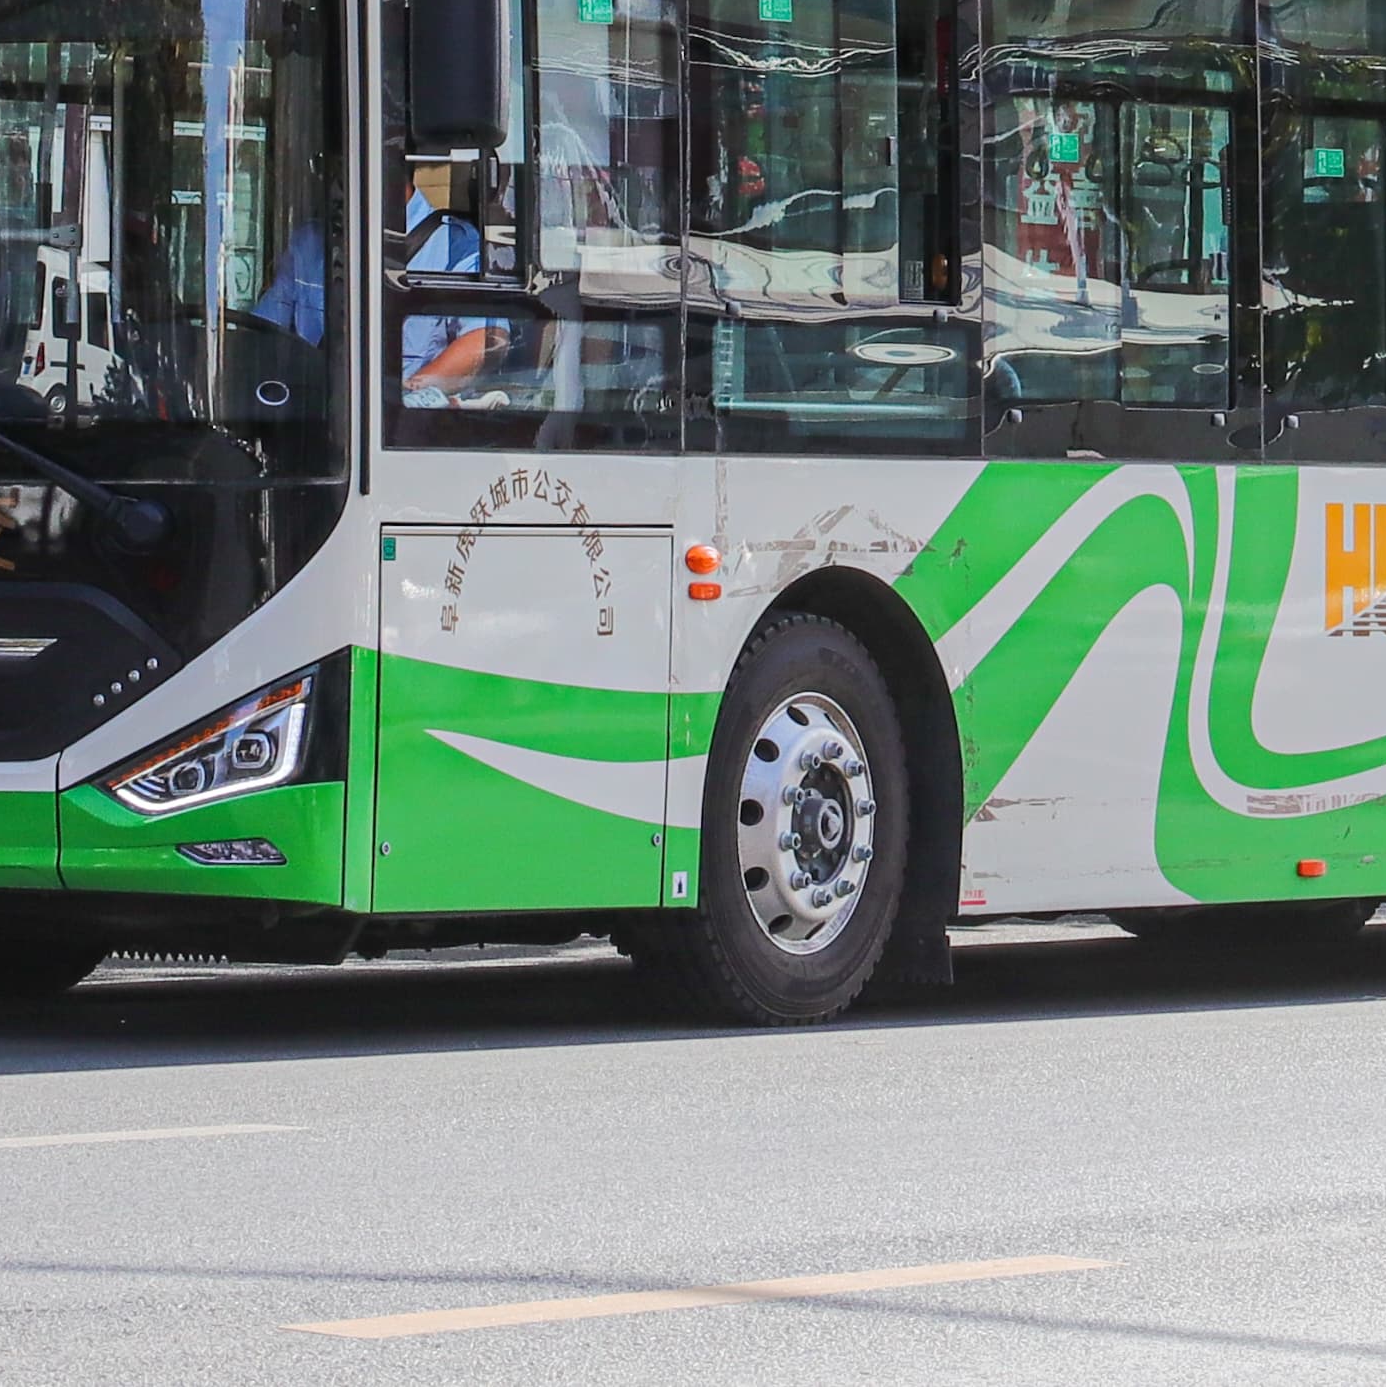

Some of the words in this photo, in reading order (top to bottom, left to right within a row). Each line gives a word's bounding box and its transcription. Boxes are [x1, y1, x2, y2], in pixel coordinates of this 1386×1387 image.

[440, 468, 614, 636] 阜新虎跃城市公交有限公司
